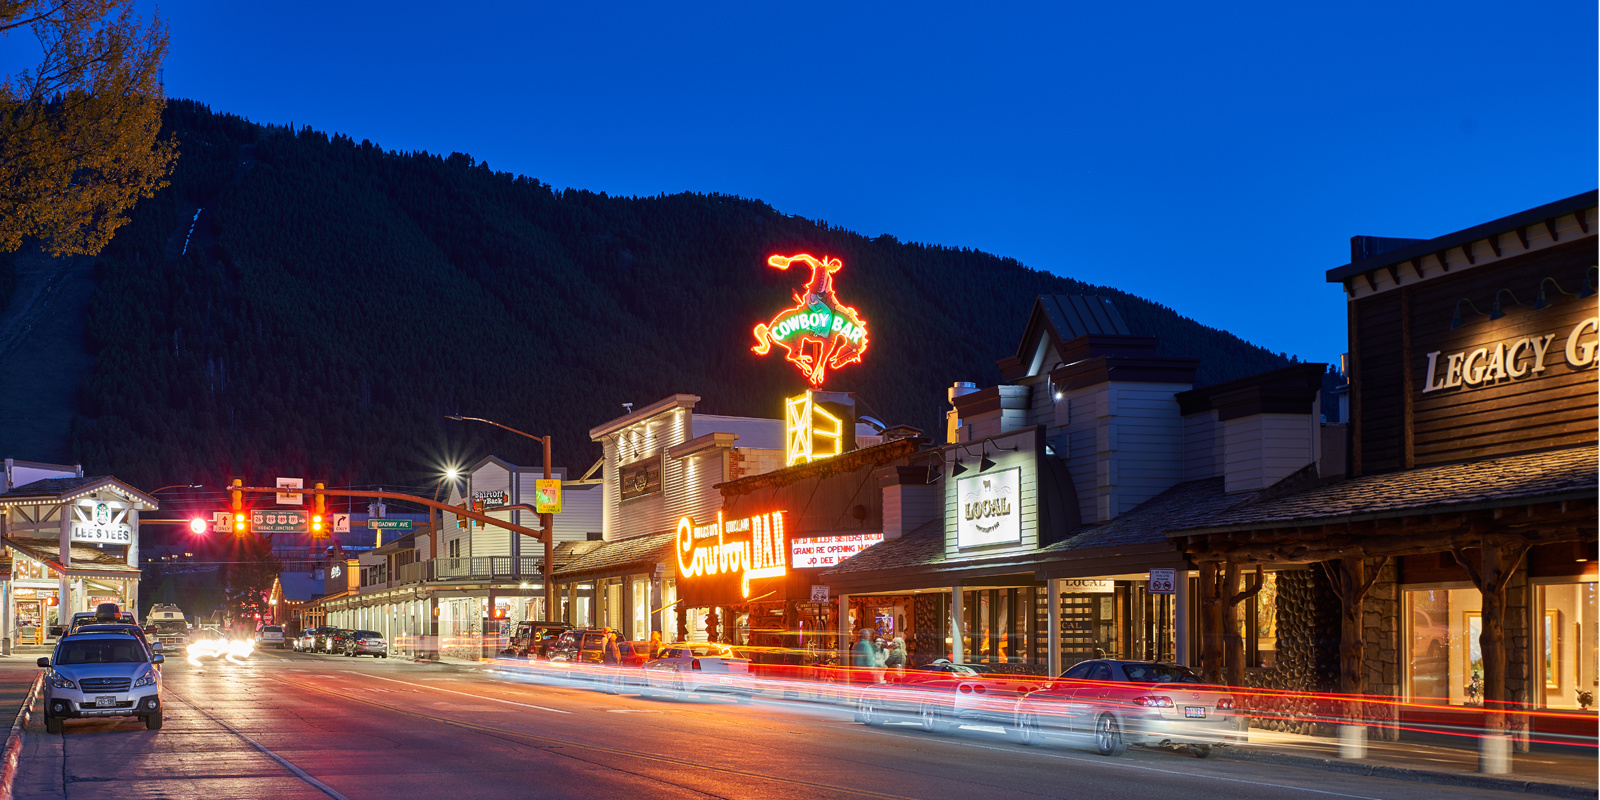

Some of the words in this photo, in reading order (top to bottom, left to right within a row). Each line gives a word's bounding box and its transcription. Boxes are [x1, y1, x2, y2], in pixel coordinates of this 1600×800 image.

[771, 312, 829, 341] COWBOY
[831, 315, 862, 344] BAR
[1422, 333, 1556, 393] LEGACY
[1565, 316, 1600, 366] G
[965, 496, 1011, 521] LOCAL
[809, 535, 833, 544] MILLER
[834, 534, 862, 543] SISTERS
[676, 510, 751, 599] Cowboy
[751, 510, 785, 569] BAR
[792, 546, 815, 555] GRAND
[816, 546, 826, 554] RE
[827, 544, 856, 554] OPENING
[807, 557, 817, 565] JO
[820, 556, 834, 564] DEE
[1065, 579, 1106, 587] LOCAL
